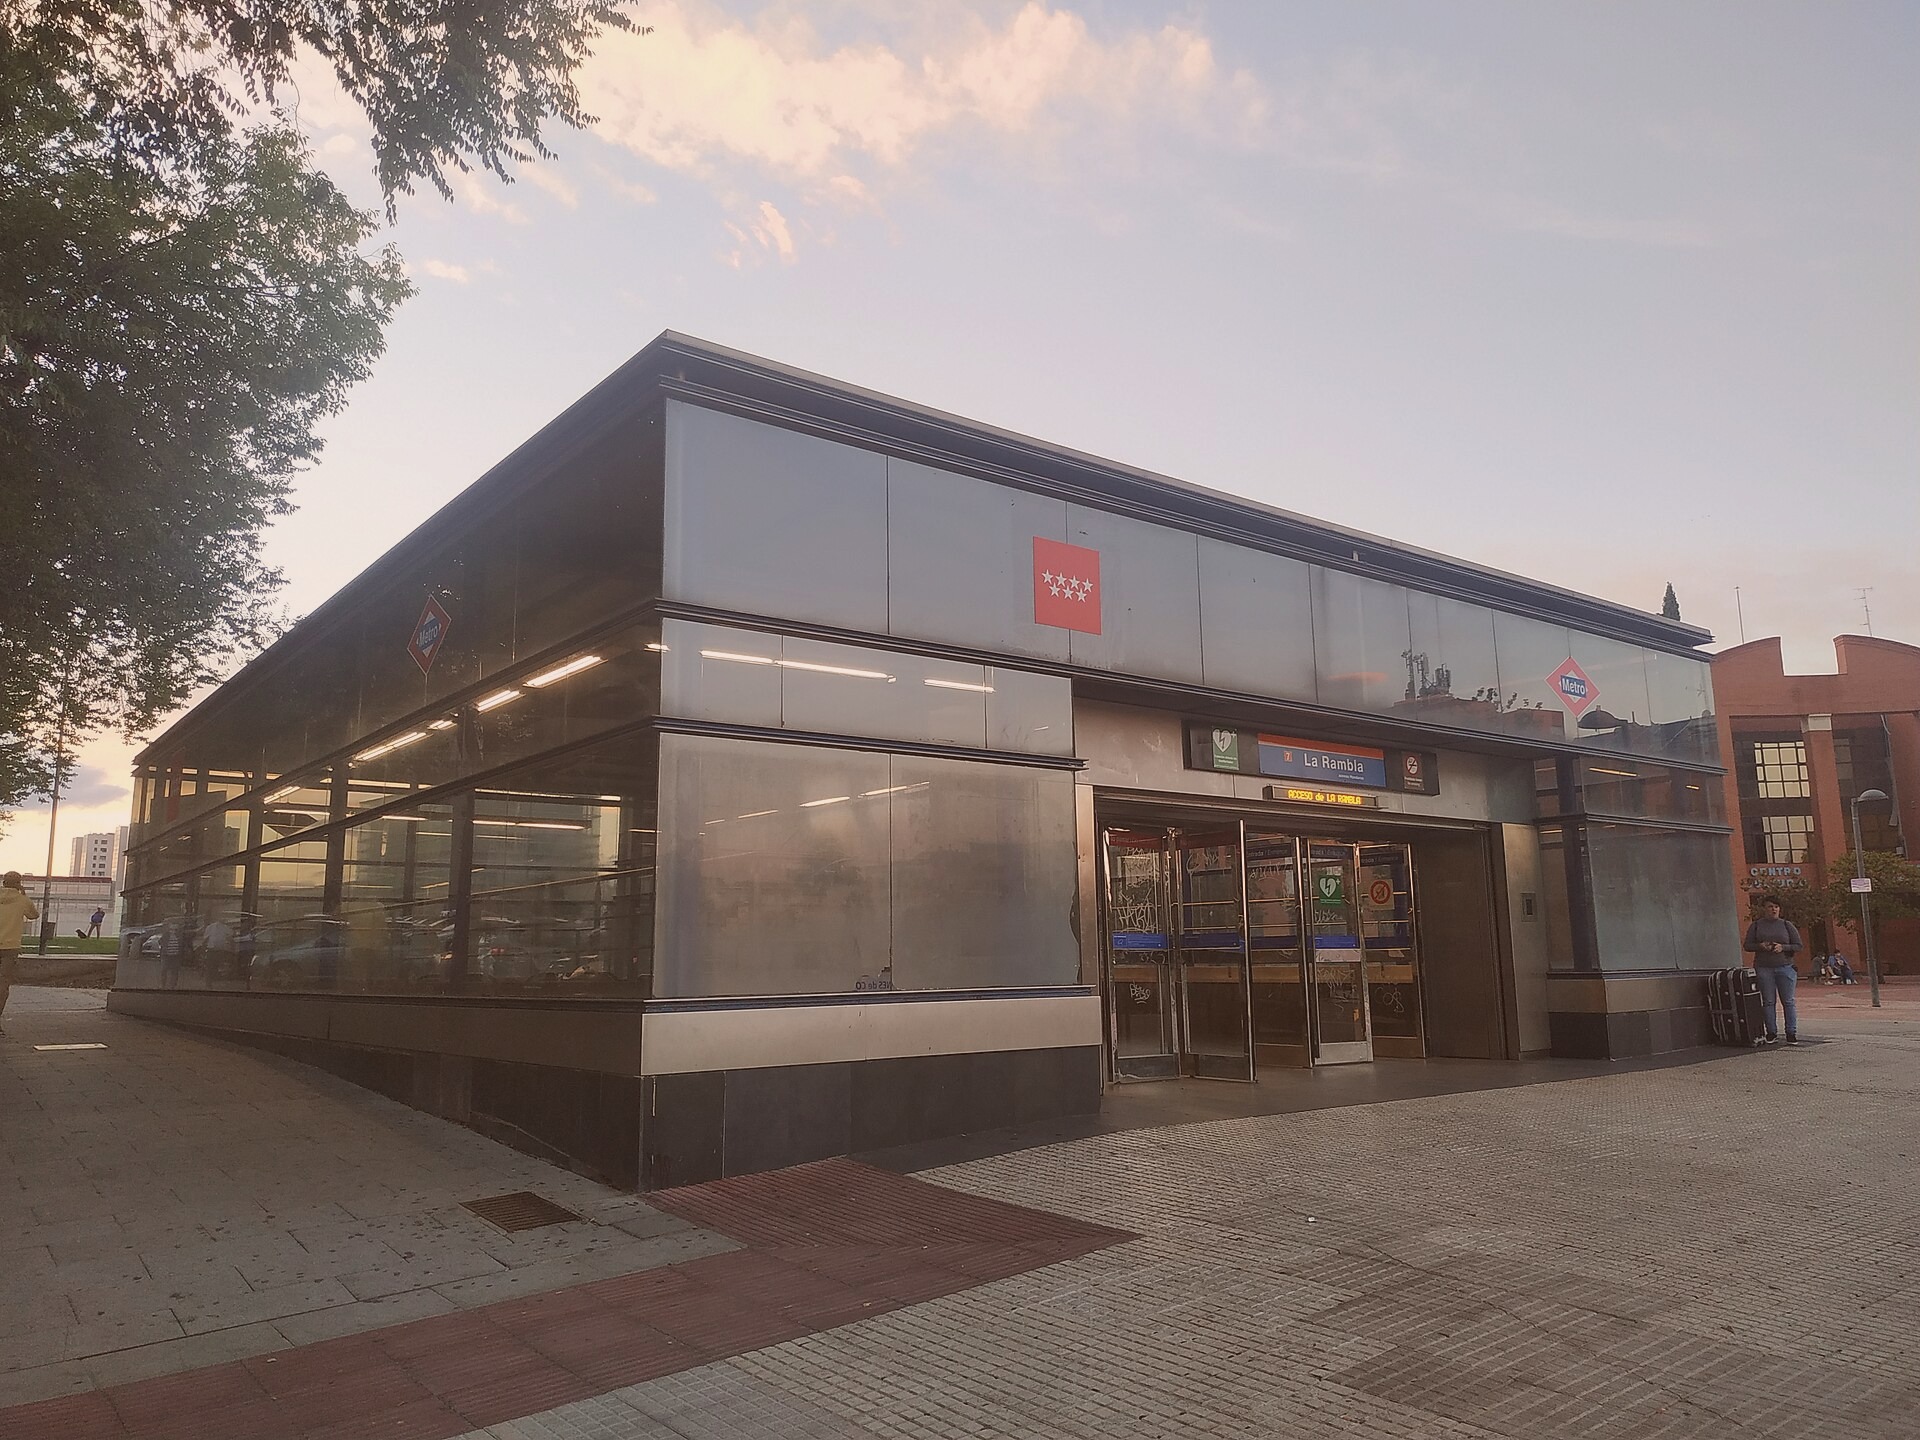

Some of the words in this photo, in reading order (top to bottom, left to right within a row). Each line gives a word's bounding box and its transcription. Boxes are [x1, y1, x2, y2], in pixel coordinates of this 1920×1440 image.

[419, 625, 437, 647] Metro
[1562, 678, 1585, 695] Metro
[1304, 753, 1318, 767] La
[1321, 755, 1365, 773] Rambla
[1288, 790, 1313, 800] ACCESO
[1315, 792, 1325, 802] de
[1326, 793, 1336, 803] LA
[1337, 794, 1362, 805] RAMBLA
